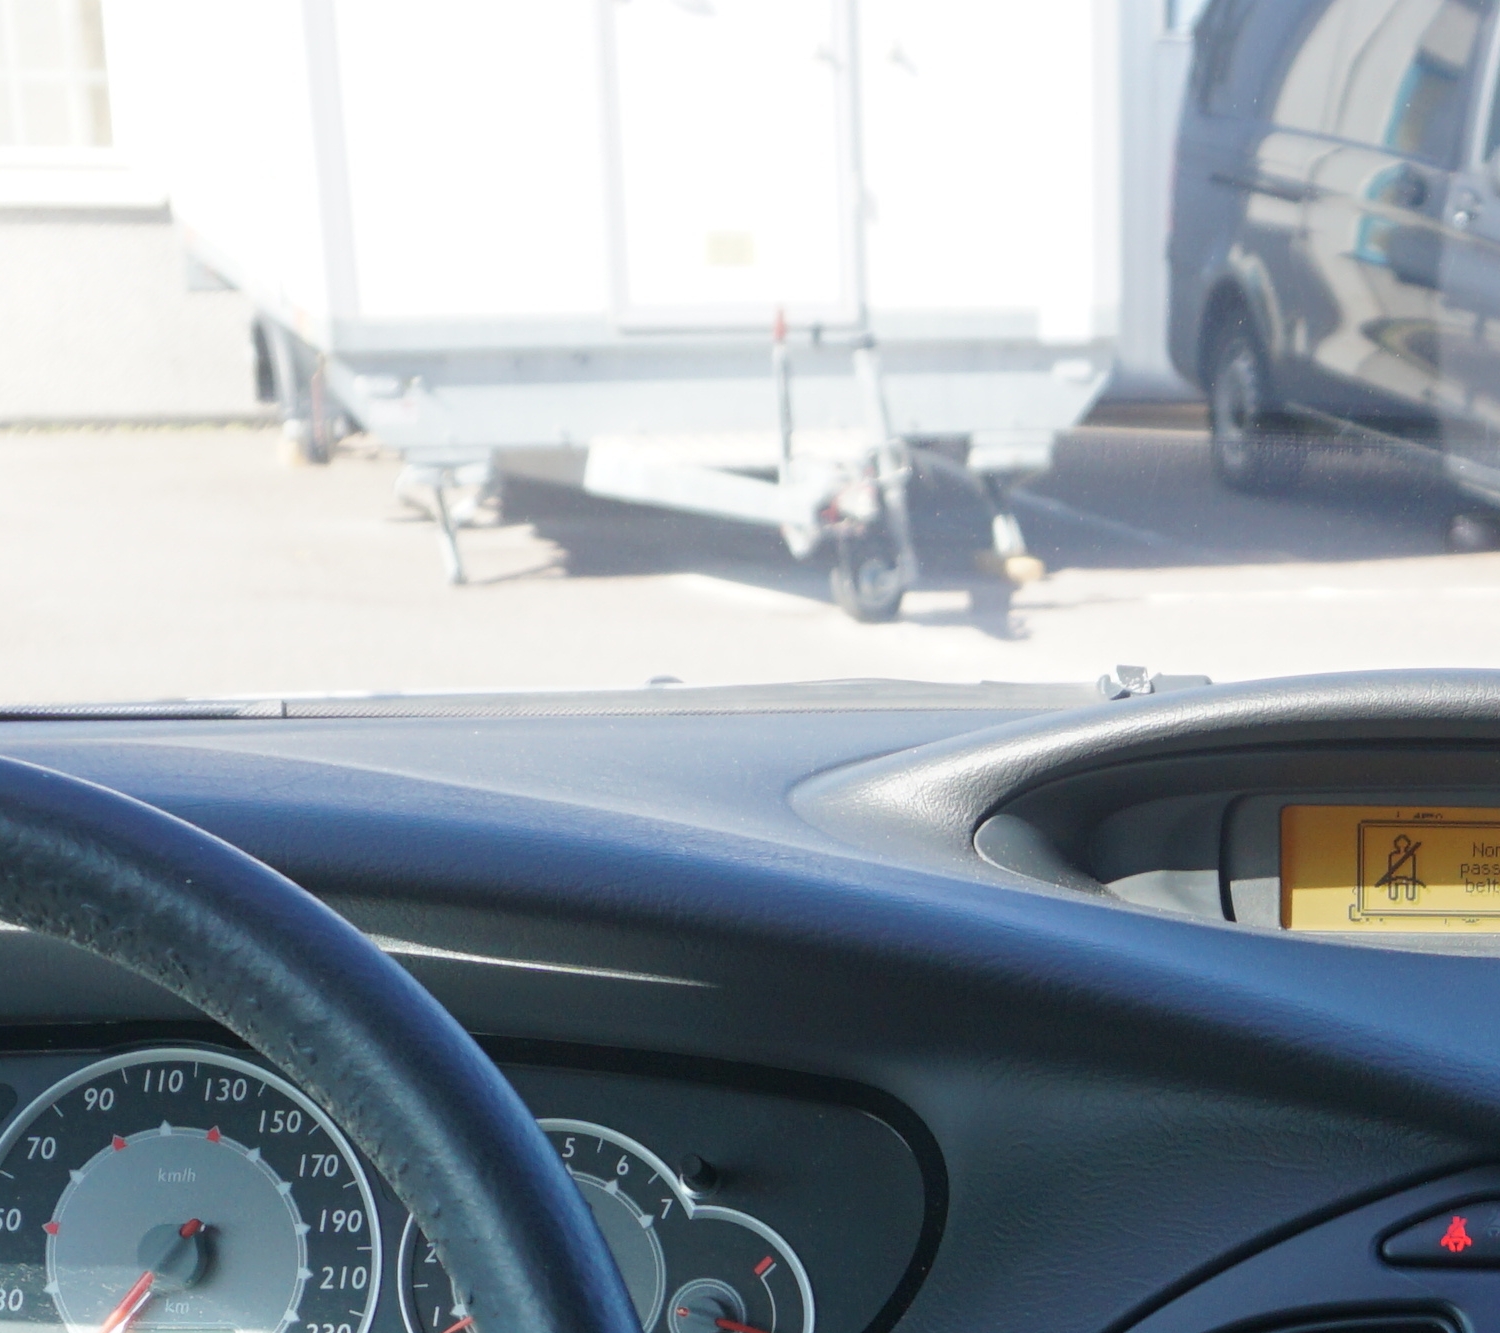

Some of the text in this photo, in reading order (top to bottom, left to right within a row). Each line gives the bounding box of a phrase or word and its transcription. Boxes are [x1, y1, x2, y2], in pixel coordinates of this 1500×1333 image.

[144, 1070, 184, 1093] 110
[204, 1078, 247, 1102] 130
[84, 1088, 114, 1112] 90
[258, 1110, 301, 1134] 150
[27, 1137, 56, 1160] 70
[562, 1138, 575, 1159] 5
[157, 1168, 196, 1183] km/h
[299, 1154, 338, 1177] 170
[617, 1156, 629, 1176] 6
[319, 1209, 362, 1232] 190
[661, 1199, 673, 1219] 7
[424, 1243, 437, 1264] 2
[319, 1266, 366, 1290] 210
[165, 1299, 190, 1314] km
